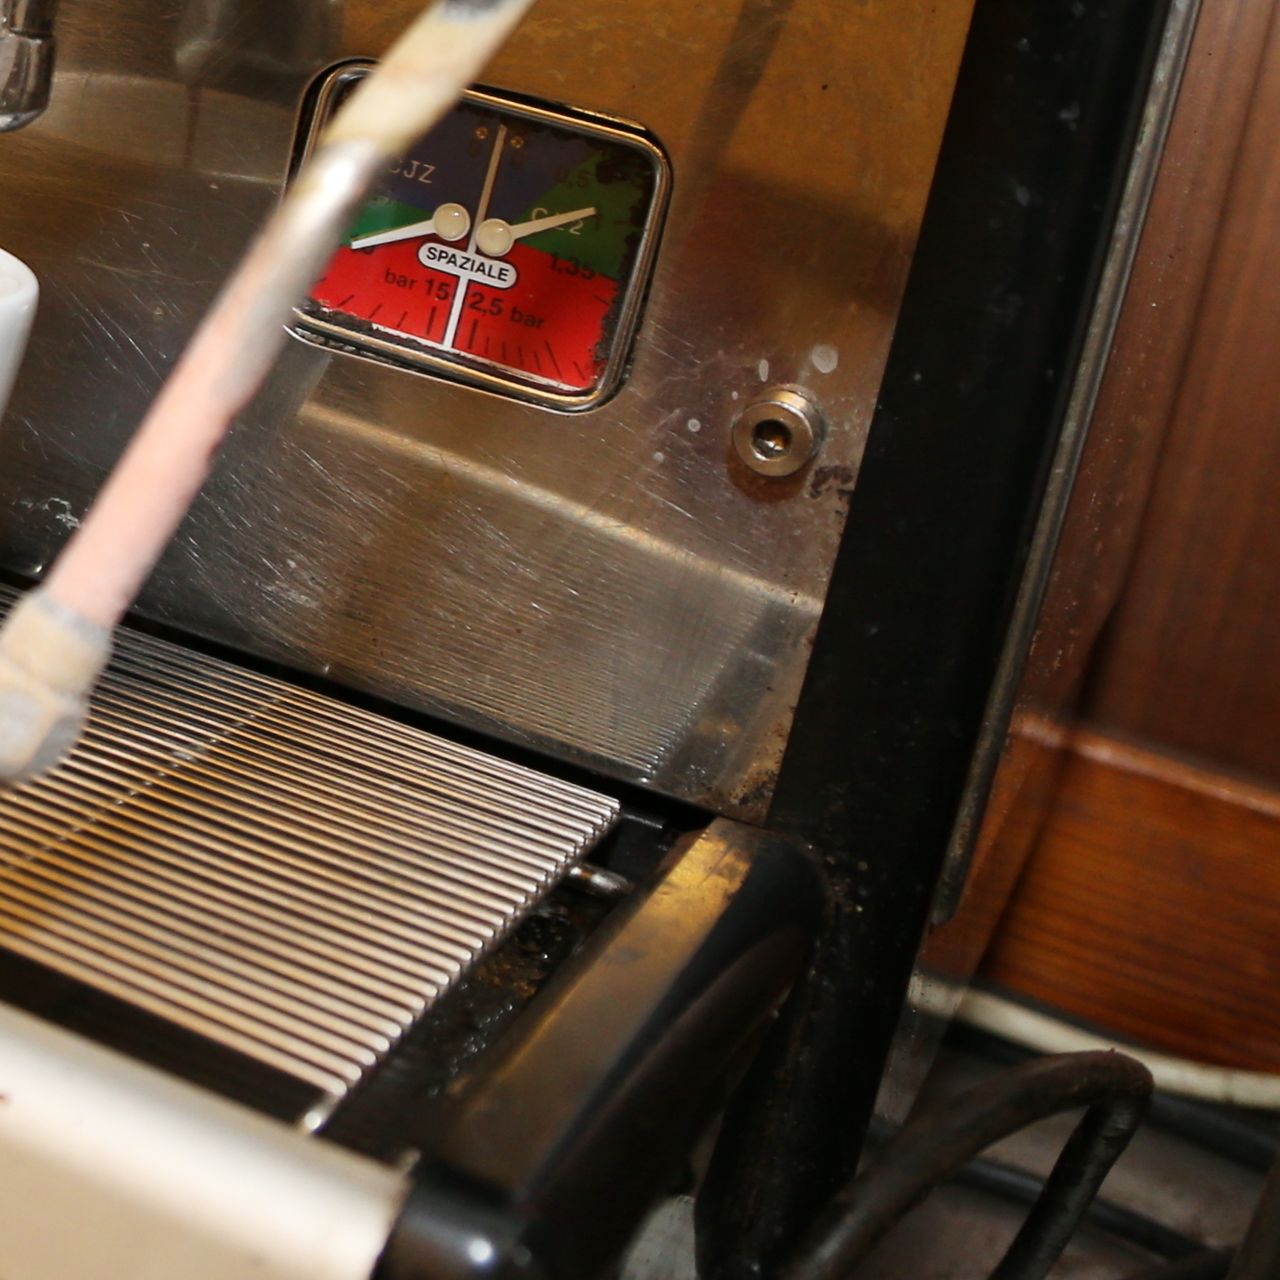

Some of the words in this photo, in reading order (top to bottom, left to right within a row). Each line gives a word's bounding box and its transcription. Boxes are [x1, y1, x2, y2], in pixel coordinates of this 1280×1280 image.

[425, 245, 510, 282] SPAZIALE
[383, 267, 417, 291] bar
[424, 277, 450, 301] 15
[469, 291, 505, 318] 2,5
[509, 297, 546, 329] bar
